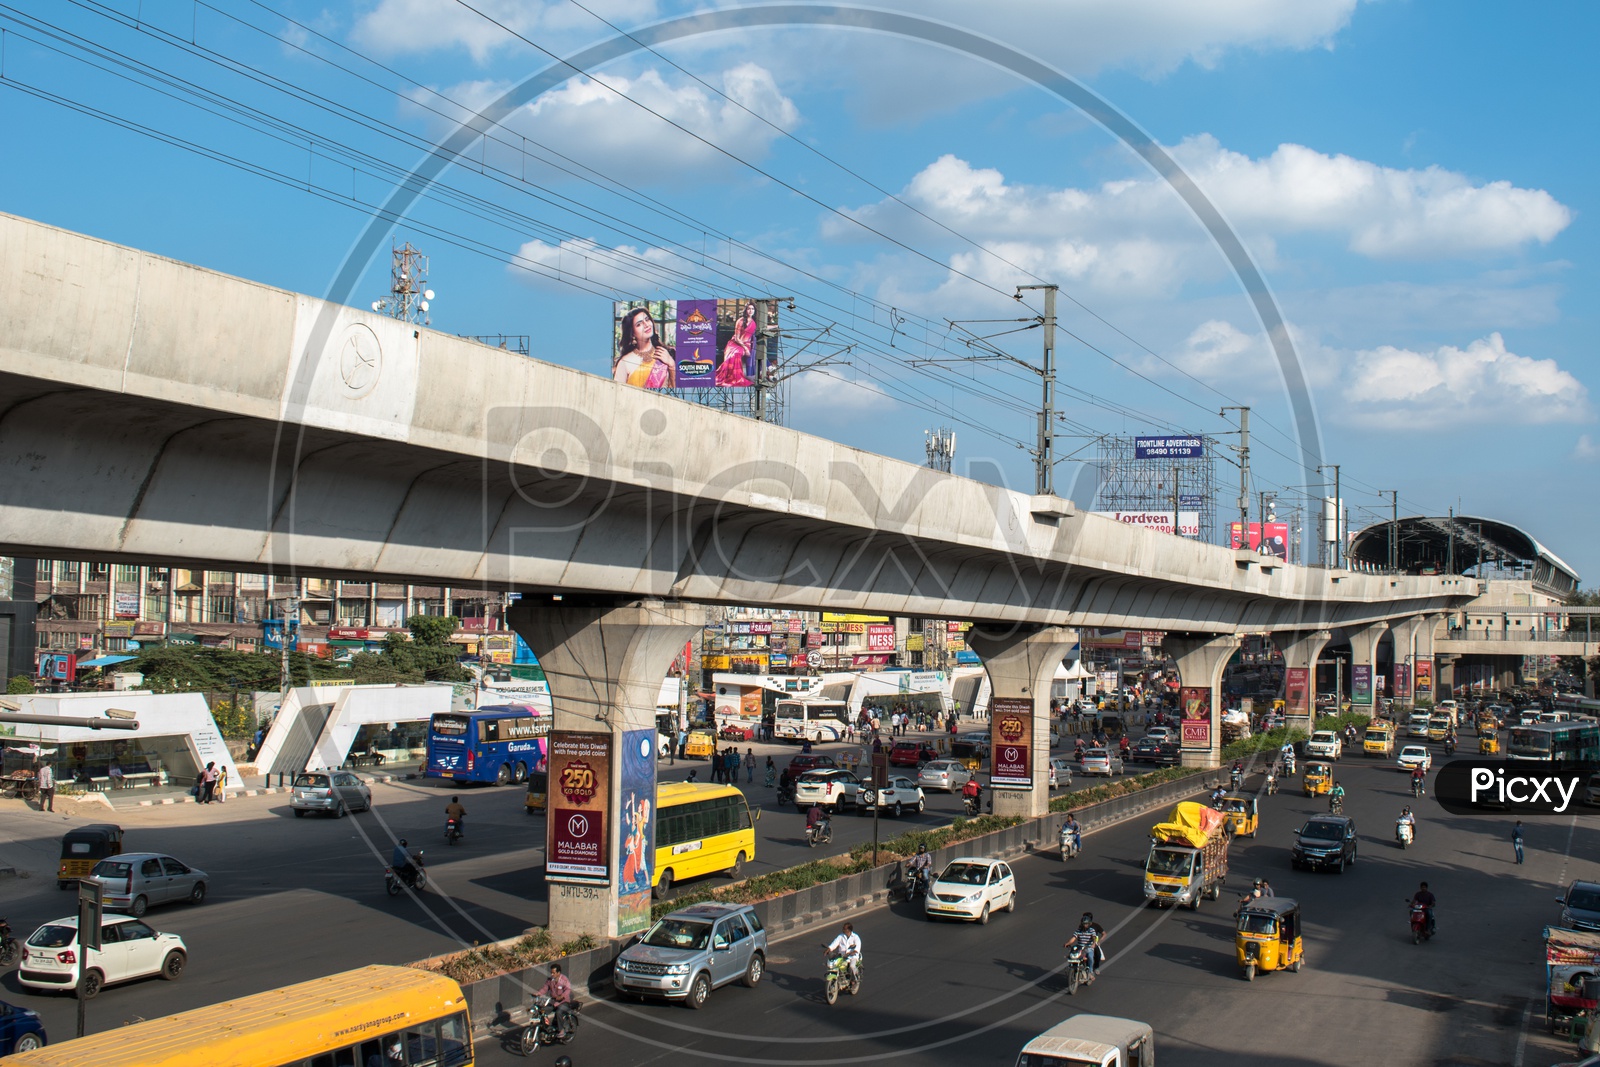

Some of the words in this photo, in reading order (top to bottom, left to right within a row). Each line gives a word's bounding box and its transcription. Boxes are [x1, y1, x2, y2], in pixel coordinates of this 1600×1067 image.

[1116, 513, 1169, 524] Lordven
[845, 623, 864, 632] MESS
[870, 634, 893, 646] MESS
[1002, 720, 1021, 732] 250
[1185, 728, 1206, 736] CMR
[508, 742, 530, 752] Garuda
[564, 768, 593, 788] 250
[558, 841, 597, 850] MALABAR
[334, 1012, 405, 1037] www.narayanagroup.com
